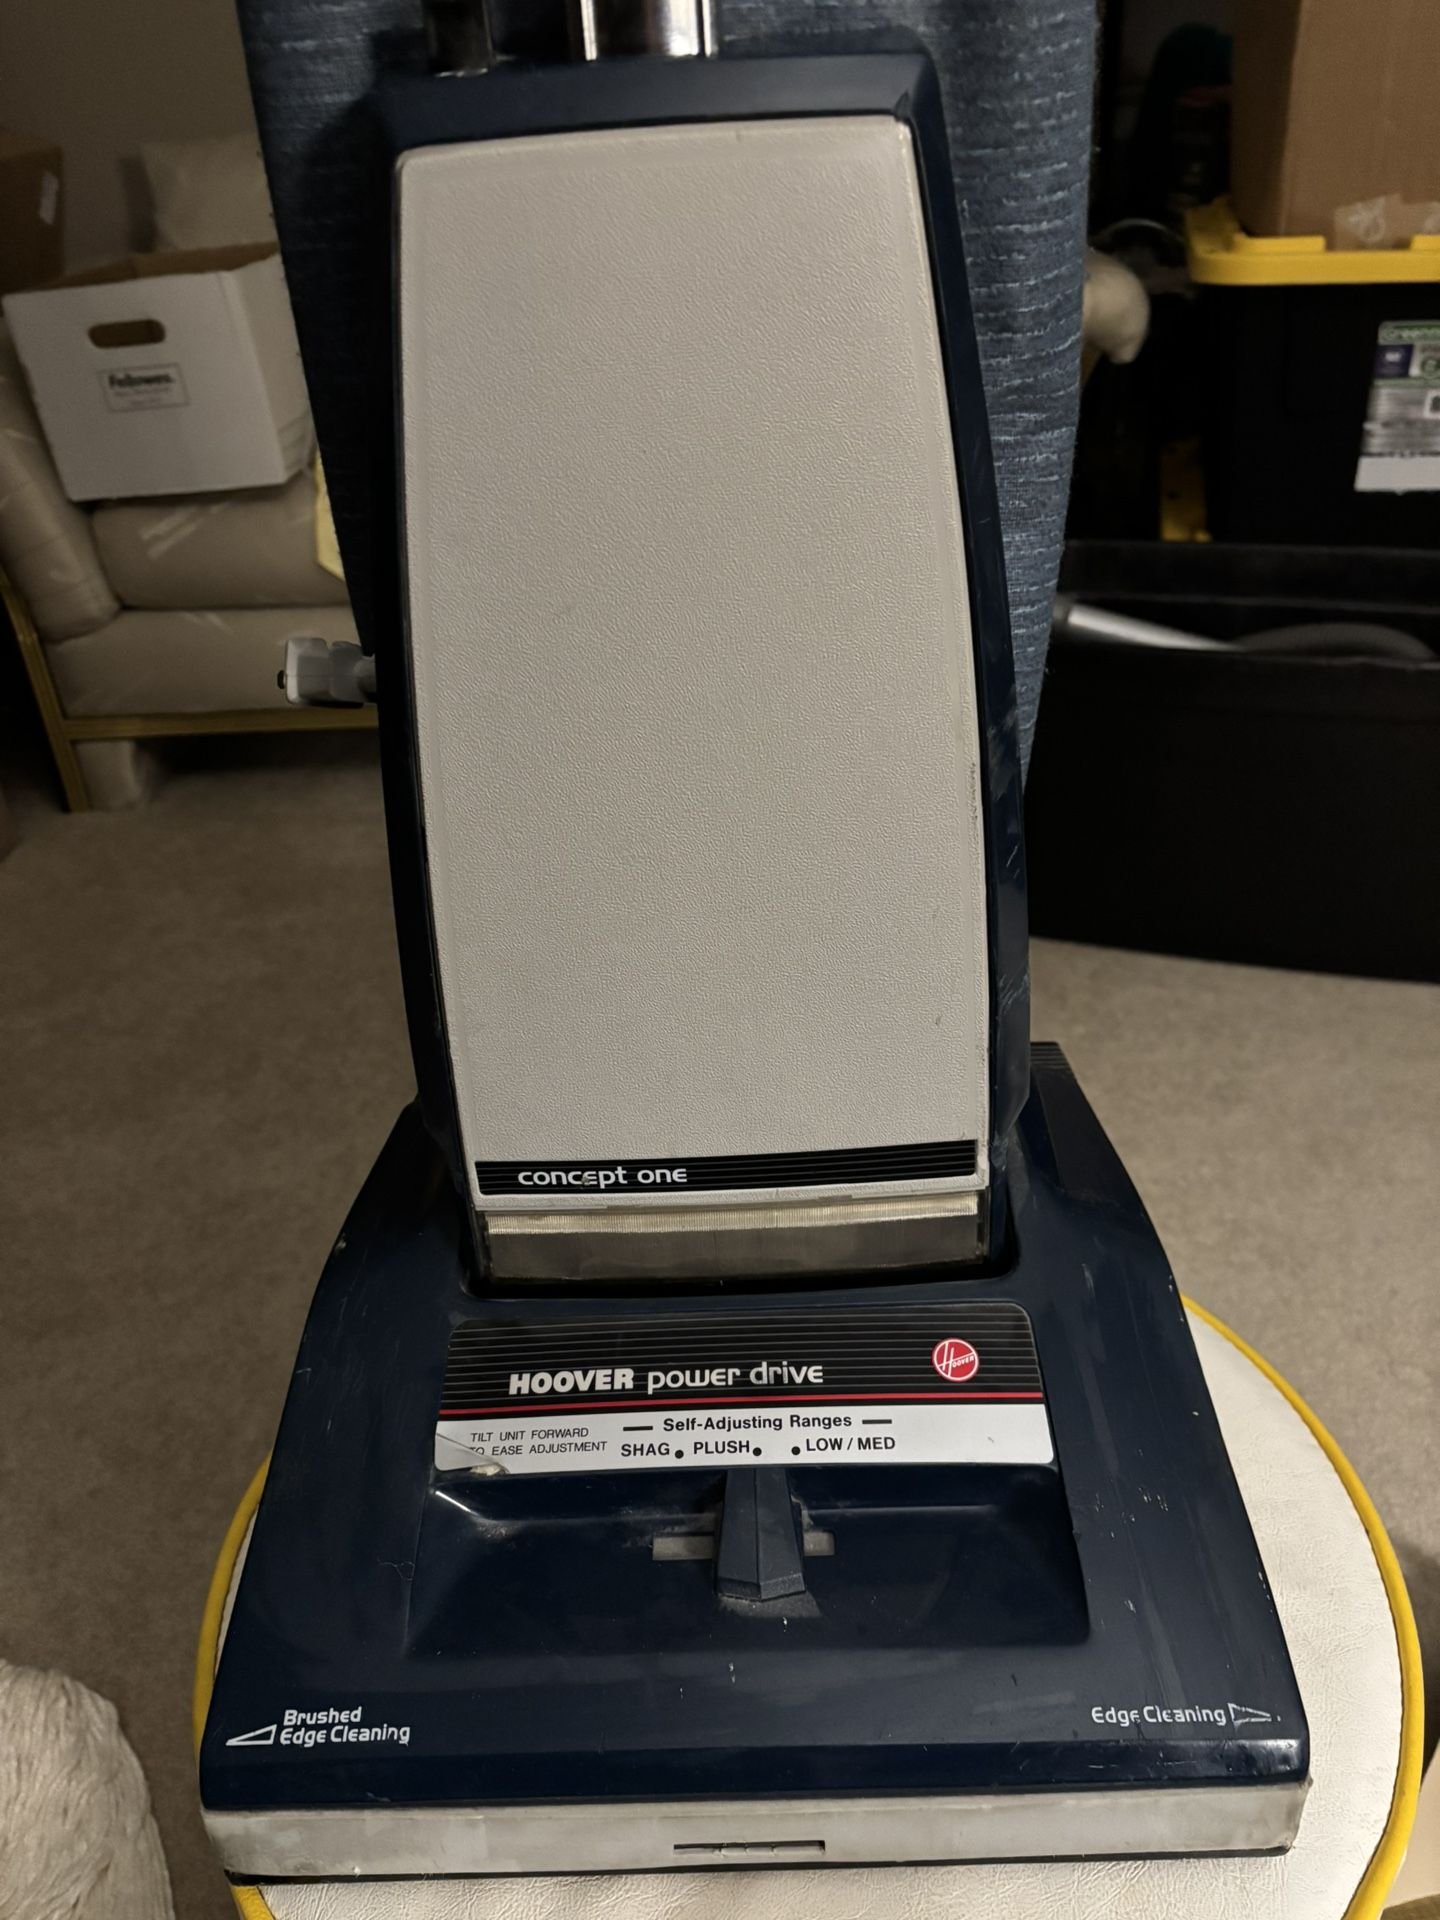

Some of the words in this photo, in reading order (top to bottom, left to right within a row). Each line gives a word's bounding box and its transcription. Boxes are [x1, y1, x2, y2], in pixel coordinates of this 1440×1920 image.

[518, 1166, 627, 1189] concept
[637, 1168, 687, 1184] one
[508, 1368, 634, 1395] HOOVER
[647, 1367, 740, 1395] power
[750, 1360, 823, 1385] drive
[663, 1415, 783, 1433] Self-Adjusting
[789, 1413, 852, 1429] Ranges
[471, 1432, 494, 1442] TILT
[499, 1430, 526, 1441] UNIT
[530, 1427, 589, 1440] FORWARD
[805, 1438, 844, 1451] LOW
[857, 1436, 896, 1450] MED
[491, 1445, 523, 1456] EASE
[529, 1441, 608, 1454] ADJUSTMENT
[620, 1442, 671, 1457] SHAG
[693, 1440, 750, 1454] PLUSH
[283, 1706, 362, 1726] Brushed
[1091, 1706, 1139, 1728] Edge
[1143, 1705, 1227, 1726] Cleaning
[280, 1727, 326, 1748] Edge
[330, 1723, 411, 1746] Cleaning
